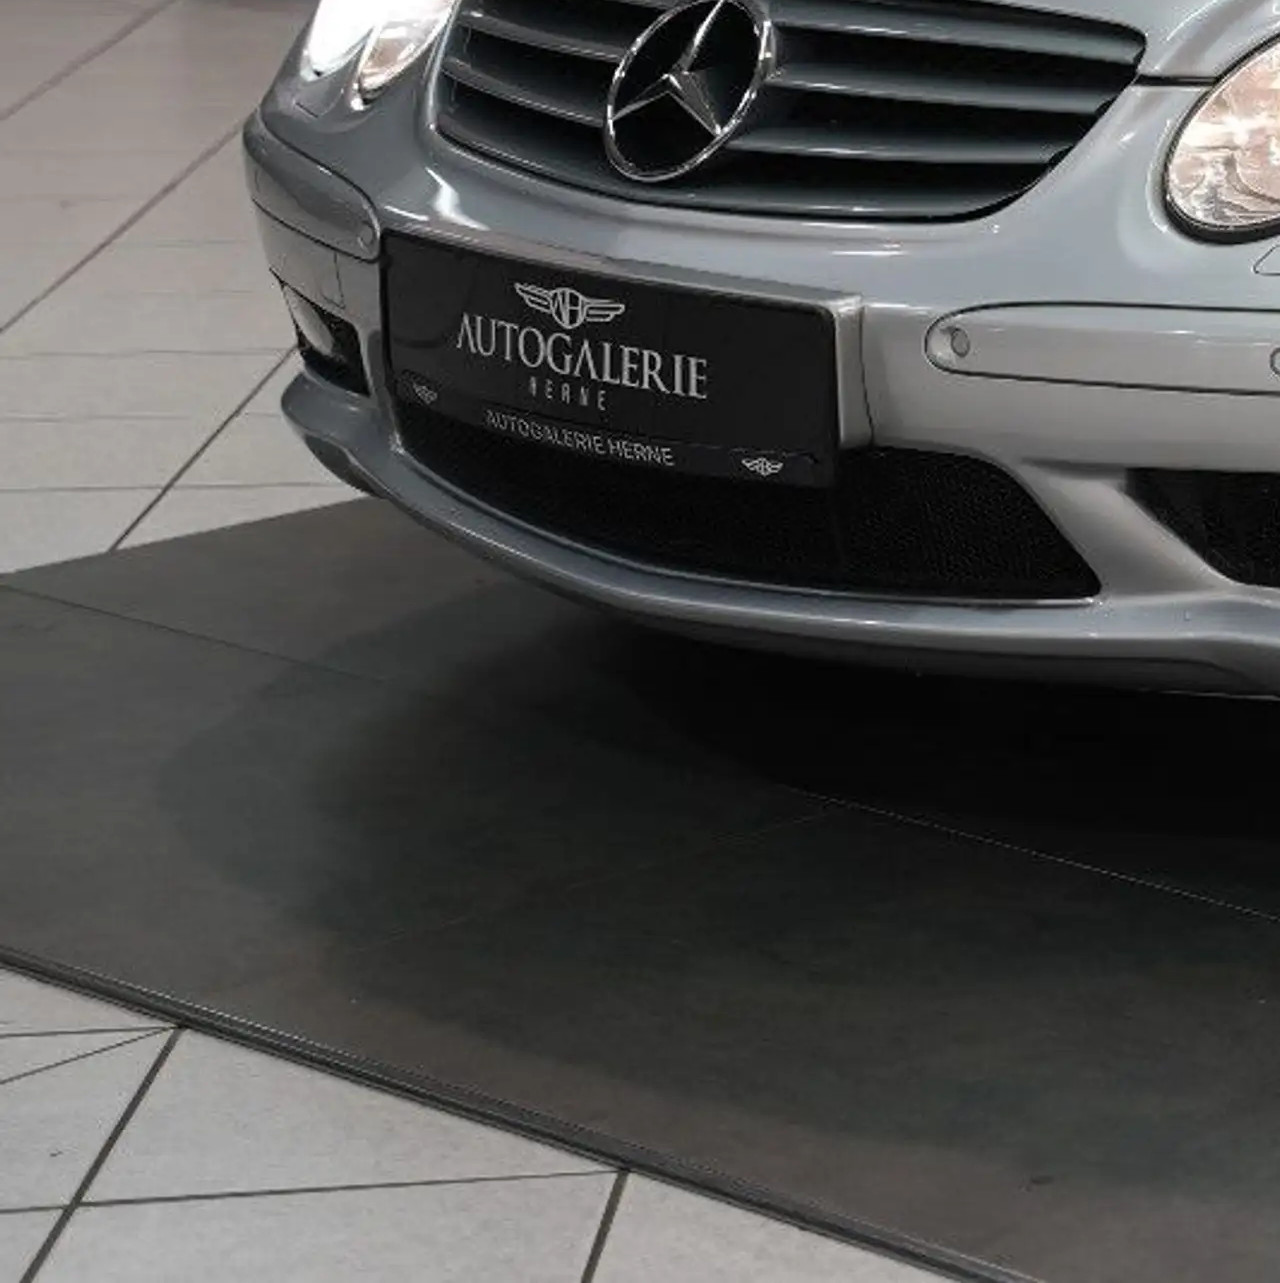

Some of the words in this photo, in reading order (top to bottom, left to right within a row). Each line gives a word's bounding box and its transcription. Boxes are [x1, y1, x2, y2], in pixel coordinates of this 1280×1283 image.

[456, 312, 708, 400] AUTOGALERIE
[528, 375, 607, 411] HERNE
[485, 409, 606, 455] AUTOGALERIE
[607, 438, 676, 467] HERNE
